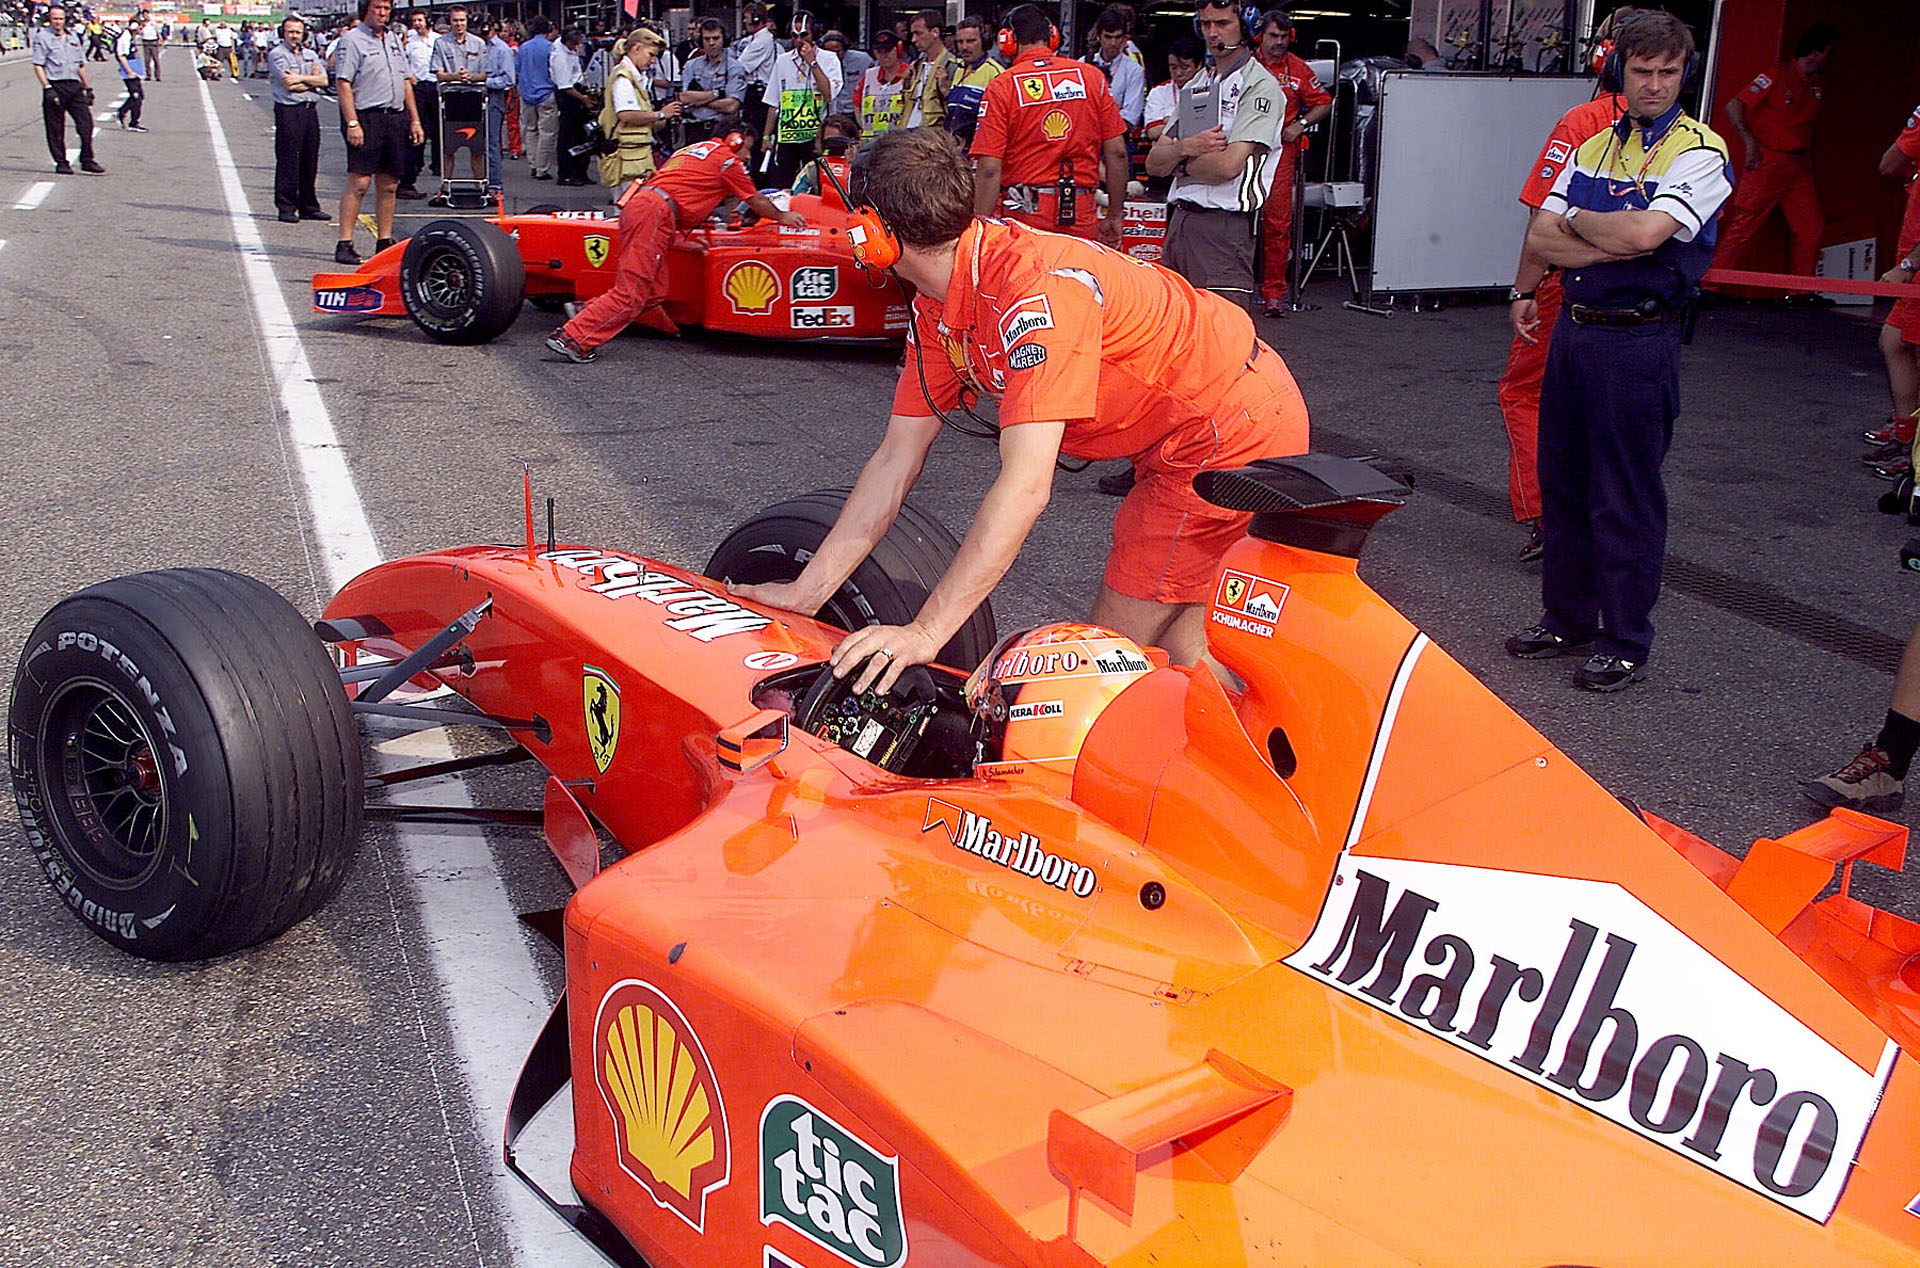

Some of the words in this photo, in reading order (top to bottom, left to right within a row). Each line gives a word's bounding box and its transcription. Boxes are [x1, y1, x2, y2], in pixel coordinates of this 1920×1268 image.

[794, 282, 832, 297] tac
[799, 269, 831, 284] tic
[318, 292, 346, 307] TIM
[792, 308, 852, 327] FedEx
[1005, 315, 1047, 346] Marlboro
[1212, 610, 1274, 639] SCHUMACHER
[1244, 602, 1277, 621] Marlboro
[992, 651, 1079, 680] arlboro
[1096, 649, 1148, 674] Marlboro
[57, 631, 189, 779] POTENZA
[1010, 703, 1062, 718] KERAKOLL
[15, 790, 138, 940] BRIDGESTONE
[957, 810, 1097, 898] Marlboro
[1309, 869, 1839, 1198] Marlboro
[790, 1111, 878, 1216] tic
[773, 1148, 886, 1263] tac
